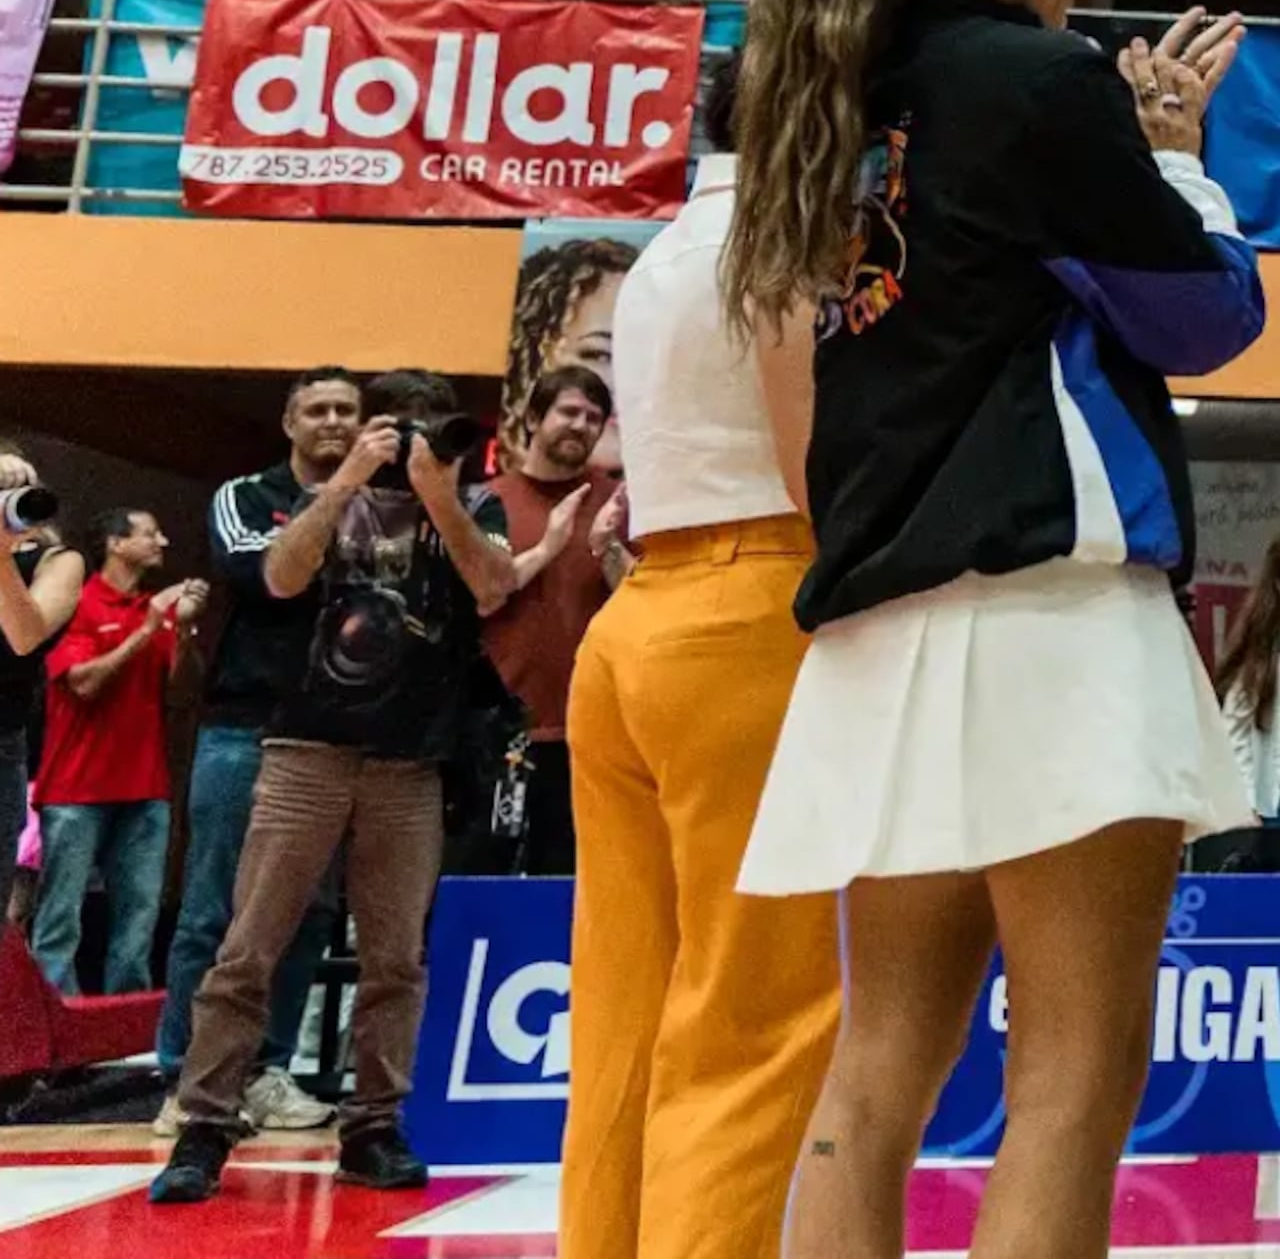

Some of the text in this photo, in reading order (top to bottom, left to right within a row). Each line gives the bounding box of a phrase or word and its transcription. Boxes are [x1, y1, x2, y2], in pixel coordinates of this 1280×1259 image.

[231, 25, 673, 149] dollar.
[190, 154, 389, 180] 787.253.2525
[419, 153, 625, 187] CAR RENTAL
